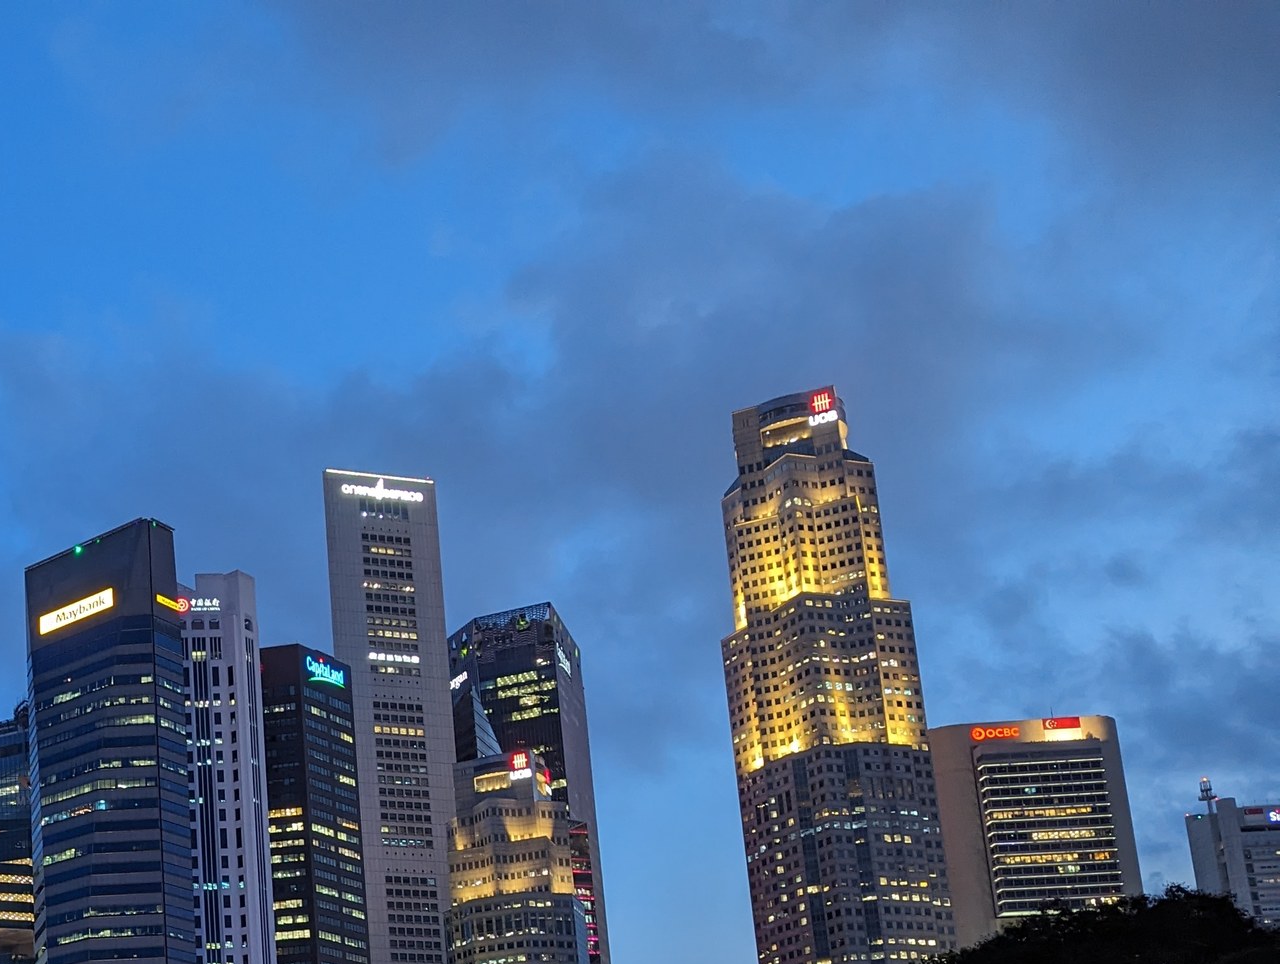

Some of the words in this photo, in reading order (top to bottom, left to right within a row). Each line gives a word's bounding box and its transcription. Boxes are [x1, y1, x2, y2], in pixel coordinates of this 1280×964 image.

[809, 410, 838, 426] UOB
[56, 596, 106, 623] Maybank
[307, 656, 344, 684] CapitaLand
[986, 727, 1020, 738] OCBC
